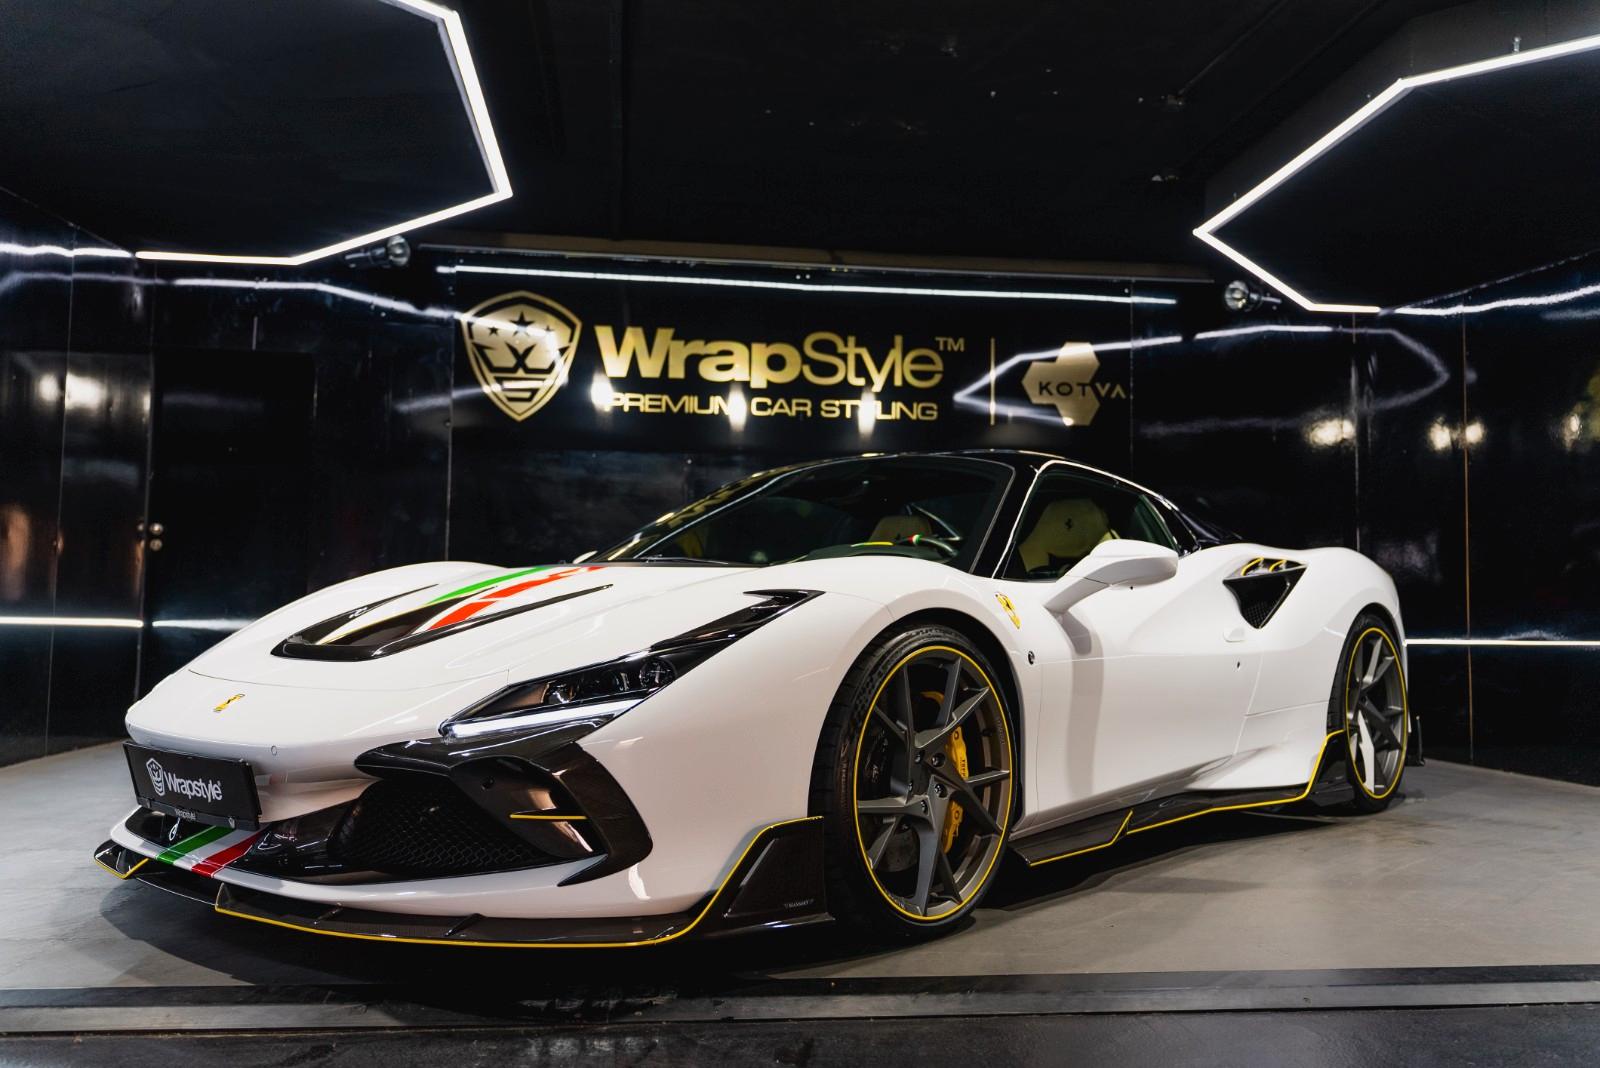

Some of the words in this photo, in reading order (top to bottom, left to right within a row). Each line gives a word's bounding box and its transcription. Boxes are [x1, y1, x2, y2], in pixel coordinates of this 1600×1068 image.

[594, 325, 943, 392] WrapStyle
[1038, 382, 1126, 399] KOTVA
[751, 396, 811, 418] CAR
[820, 399, 938, 421] STLING
[164, 771, 222, 803] Wrapstyle
